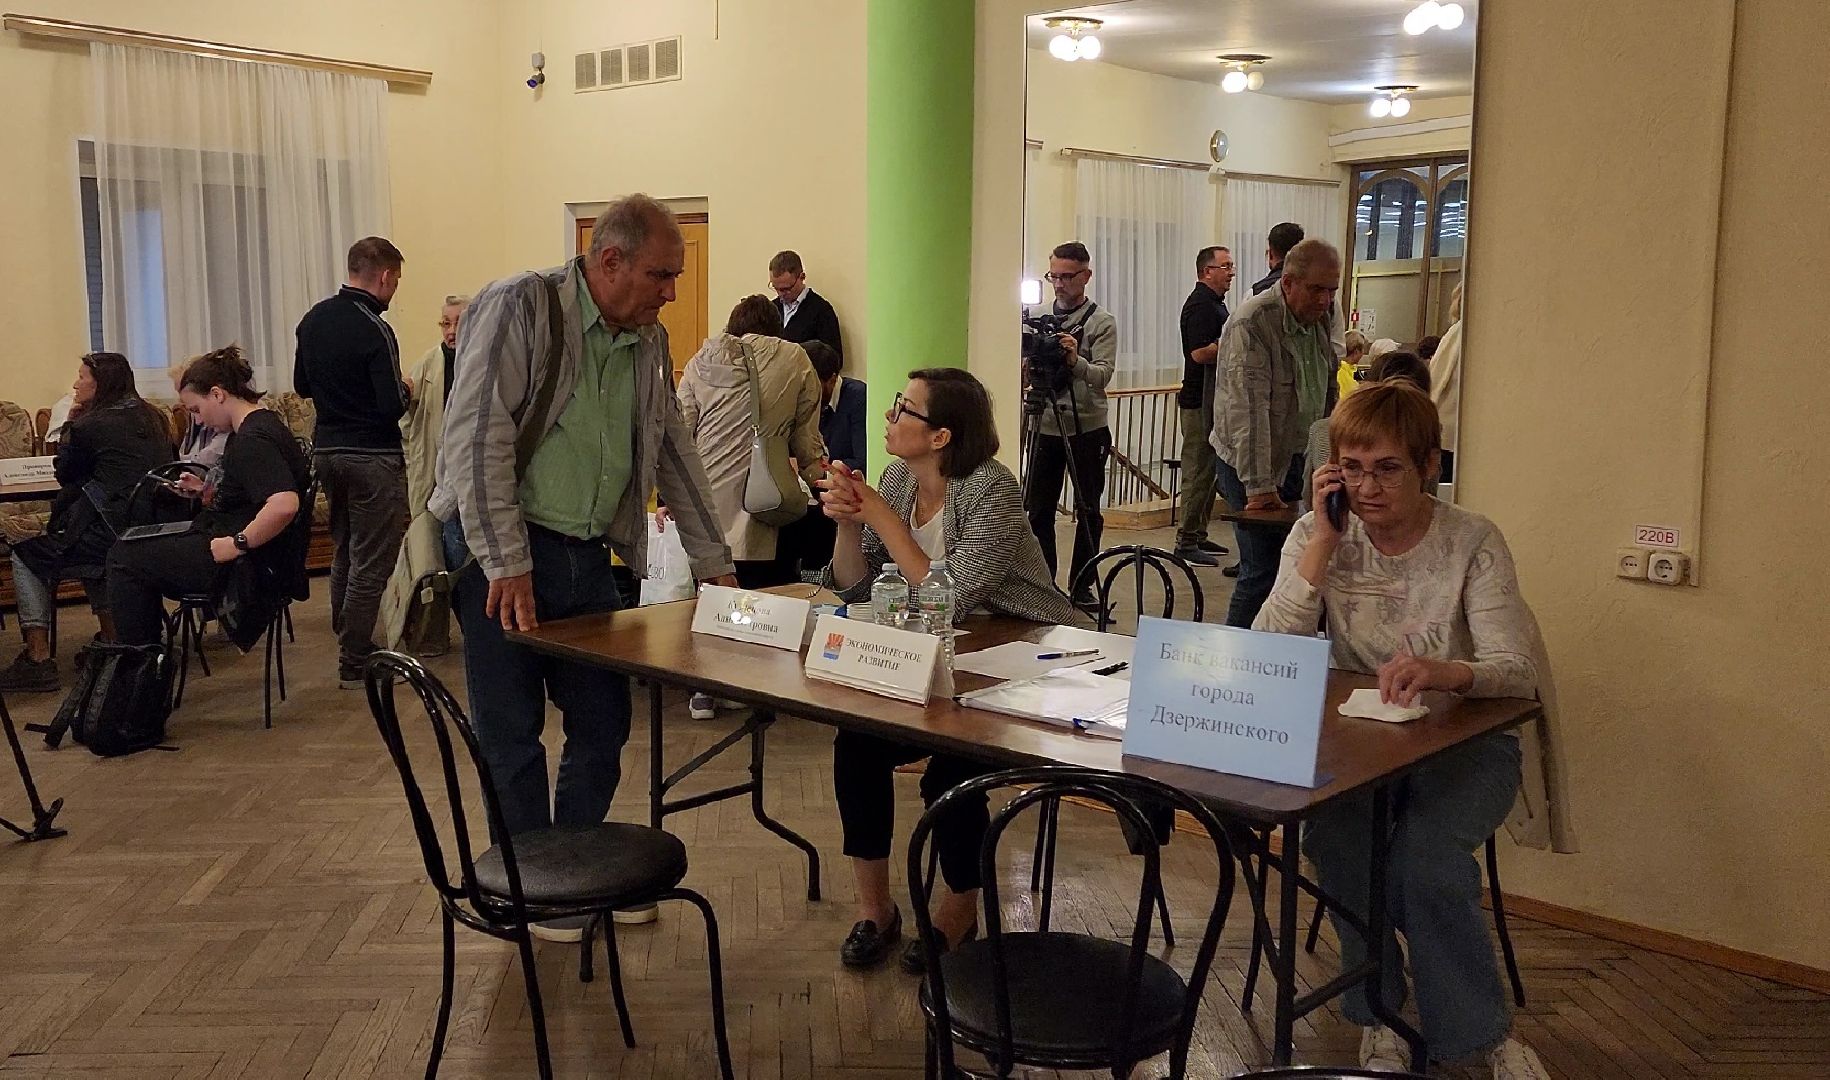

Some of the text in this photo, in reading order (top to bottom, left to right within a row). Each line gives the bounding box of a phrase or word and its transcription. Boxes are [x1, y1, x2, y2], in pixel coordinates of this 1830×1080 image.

[1639, 529, 1675, 544] 220В
[1160, 642, 1298, 680] Банк вакансий
[1191, 683, 1255, 706] города
[1150, 705, 1289, 745] Дзержинского
